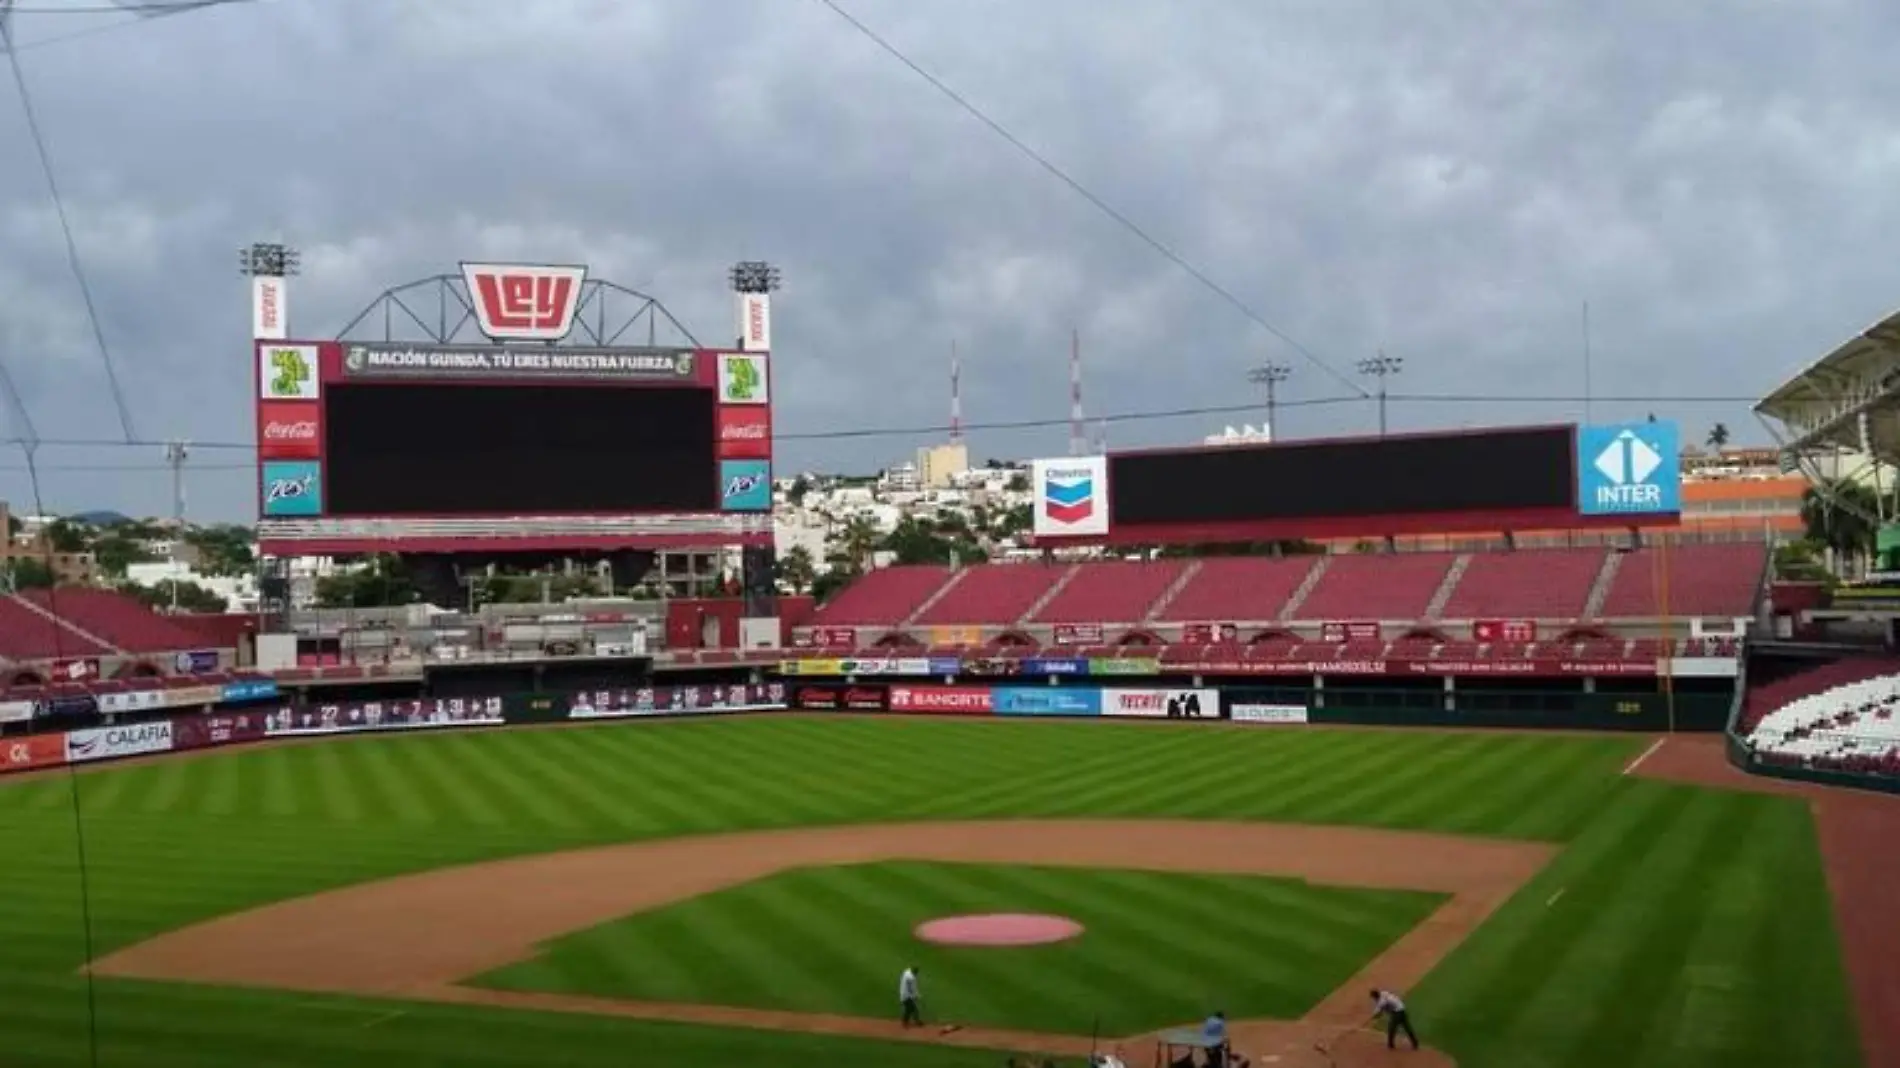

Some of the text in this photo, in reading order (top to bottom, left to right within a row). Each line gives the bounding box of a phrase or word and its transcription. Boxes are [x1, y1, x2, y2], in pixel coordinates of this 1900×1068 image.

[368, 347, 674, 370] NACIÓN GUINDA, TÚ ERES NUESTRA FUERZA
[1597, 484, 1661, 504] INTER
[105, 724, 170, 746] CALAFIA
